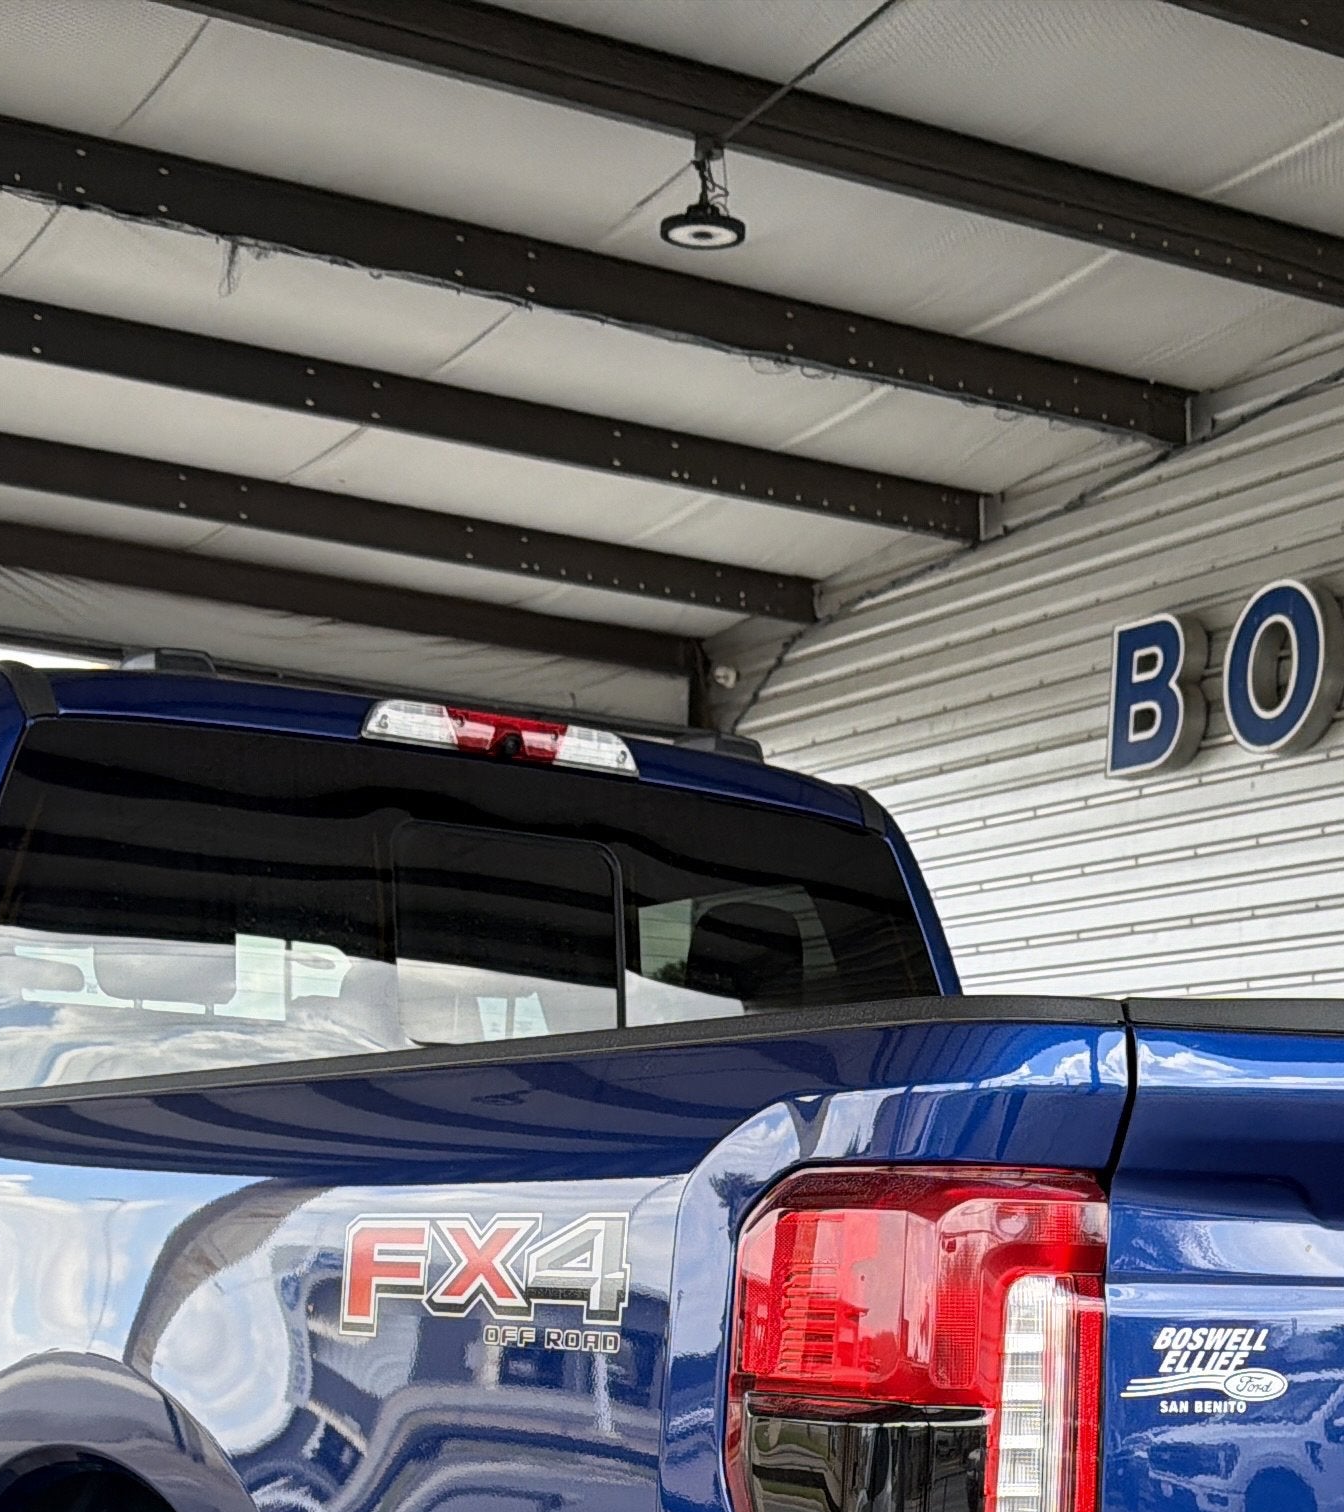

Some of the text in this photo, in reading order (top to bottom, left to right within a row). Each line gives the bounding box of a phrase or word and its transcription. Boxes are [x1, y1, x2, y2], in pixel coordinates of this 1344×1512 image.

[339, 1211, 630, 1337] FX4
[483, 1325, 621, 1353] OFF ROAD
[1152, 1327, 1269, 1351] BOSWELL
[1158, 1351, 1249, 1373] ELLIFF
[1236, 1375, 1273, 1393] Ford
[1160, 1400, 1247, 1413] SAN BENITO
